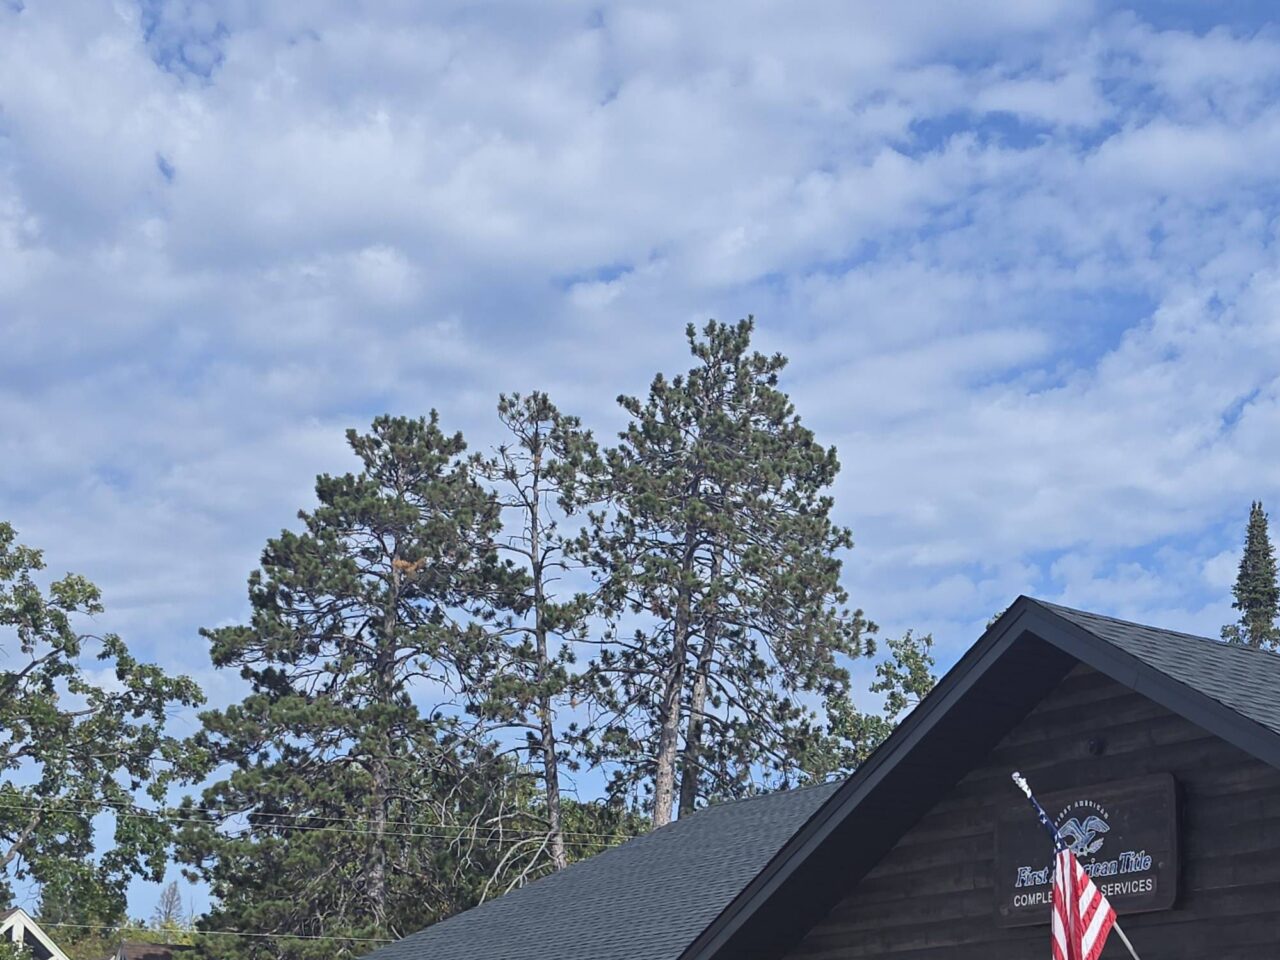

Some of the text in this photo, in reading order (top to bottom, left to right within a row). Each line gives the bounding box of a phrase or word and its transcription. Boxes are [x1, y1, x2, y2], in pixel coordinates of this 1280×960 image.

[1015, 866, 1048, 888] First
[1119, 850, 1152, 873] Title
[1014, 879, 1153, 907] COMPLE SERVICES
